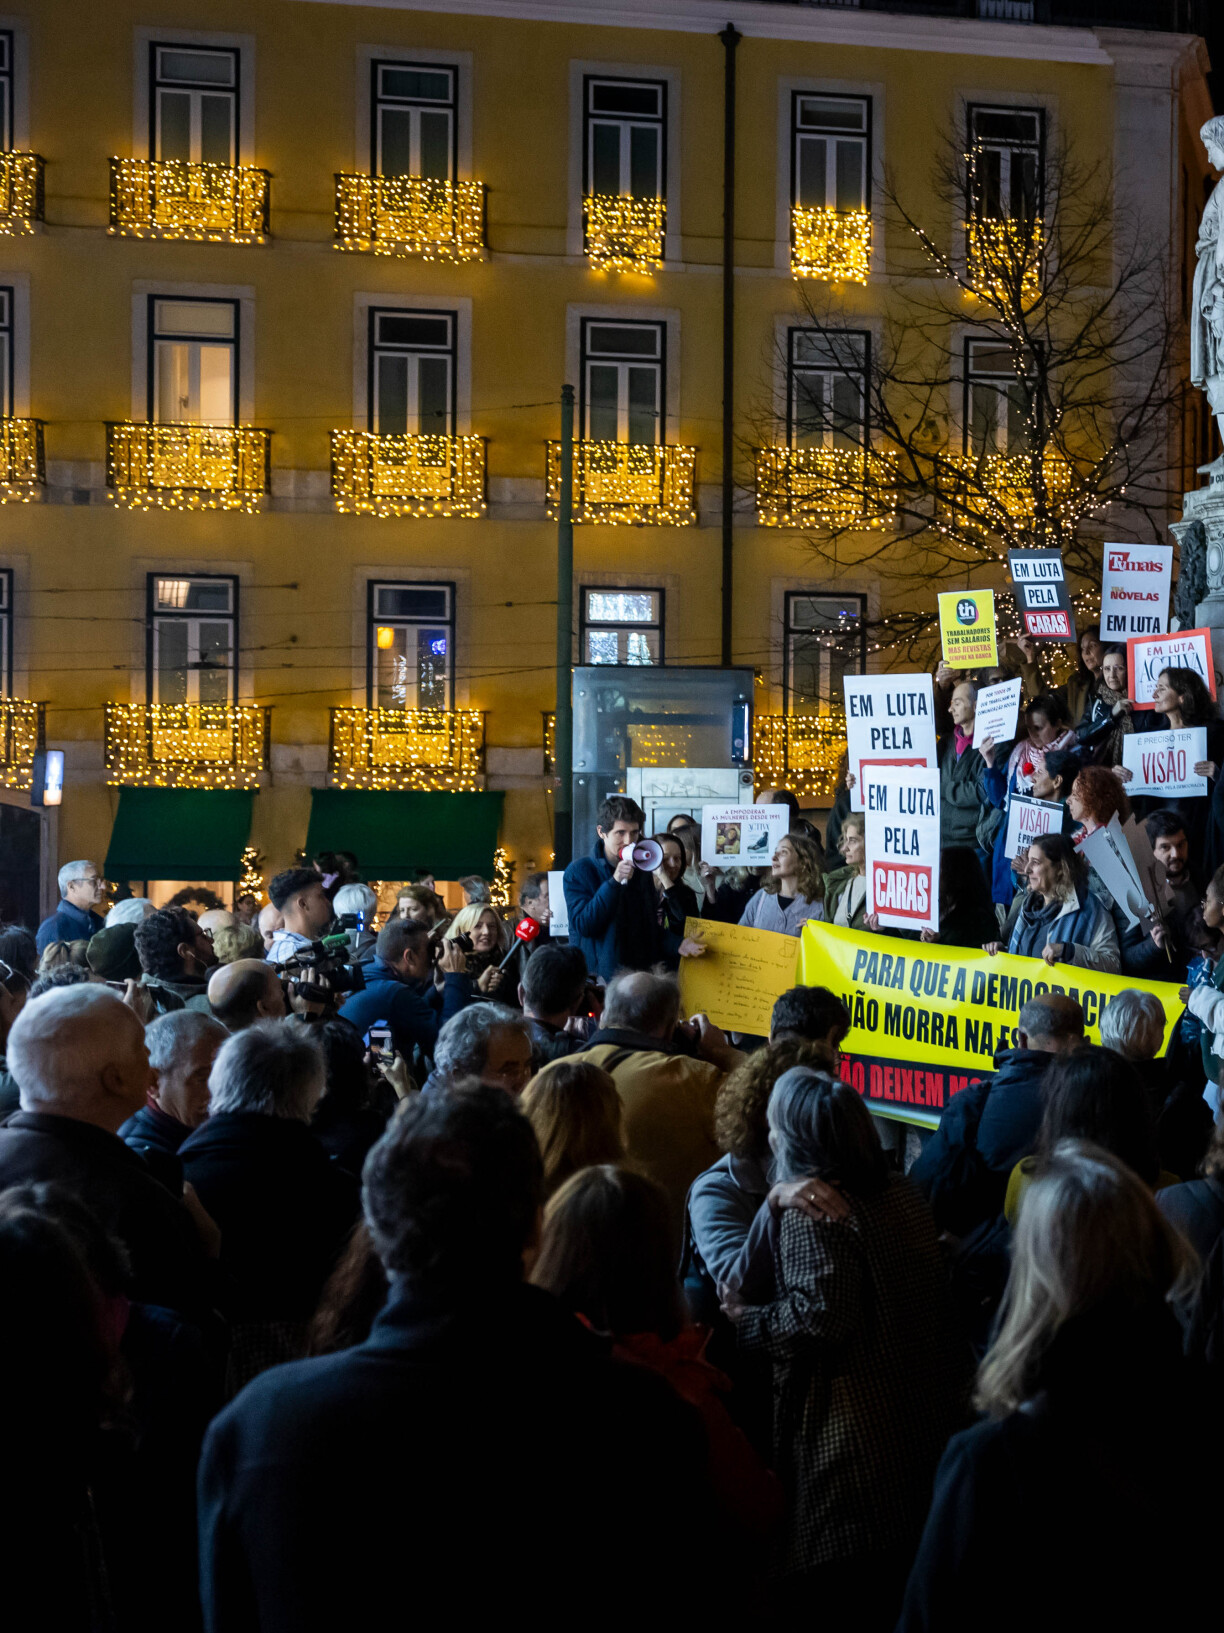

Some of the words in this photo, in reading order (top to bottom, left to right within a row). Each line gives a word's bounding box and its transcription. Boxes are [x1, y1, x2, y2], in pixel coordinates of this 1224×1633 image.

[1014, 563, 1030, 578] EM
[1033, 562, 1060, 577] LUTA
[1028, 589, 1055, 604] PELA
[1110, 591, 1160, 601] NOVELAS
[946, 627, 991, 637] TRABALHADORES
[1027, 614, 1067, 634] CARAS
[1107, 615, 1126, 632] EM
[1131, 616, 1160, 633] LUTA
[947, 637, 960, 645] SEM
[948, 646, 961, 654] MAS
[962, 644, 991, 653] REVISTAS
[1147, 646, 1163, 656] EM
[1169, 642, 1195, 653] LUTA
[850, 694, 874, 717] EM
[886, 692, 928, 717] LUTA
[871, 726, 913, 751] PELA
[1137, 737, 1142, 746] É
[1144, 734, 1175, 745] PRECISO
[1178, 733, 1192, 742] TER
[1142, 745, 1186, 784] VISÃO
[868, 784, 888, 812] EM
[899, 786, 935, 816] LUTA
[1019, 807, 1050, 834] VISÃO
[884, 826, 920, 857] PELA
[874, 867, 930, 914] CARAS
[852, 949, 906, 991] PARA
[909, 959, 951, 998] QUE
[951, 967, 967, 1003] A
[884, 1001, 959, 1050] MORRA
[965, 1017, 994, 1057] NA
[870, 1064, 944, 1108] DEIXEM
